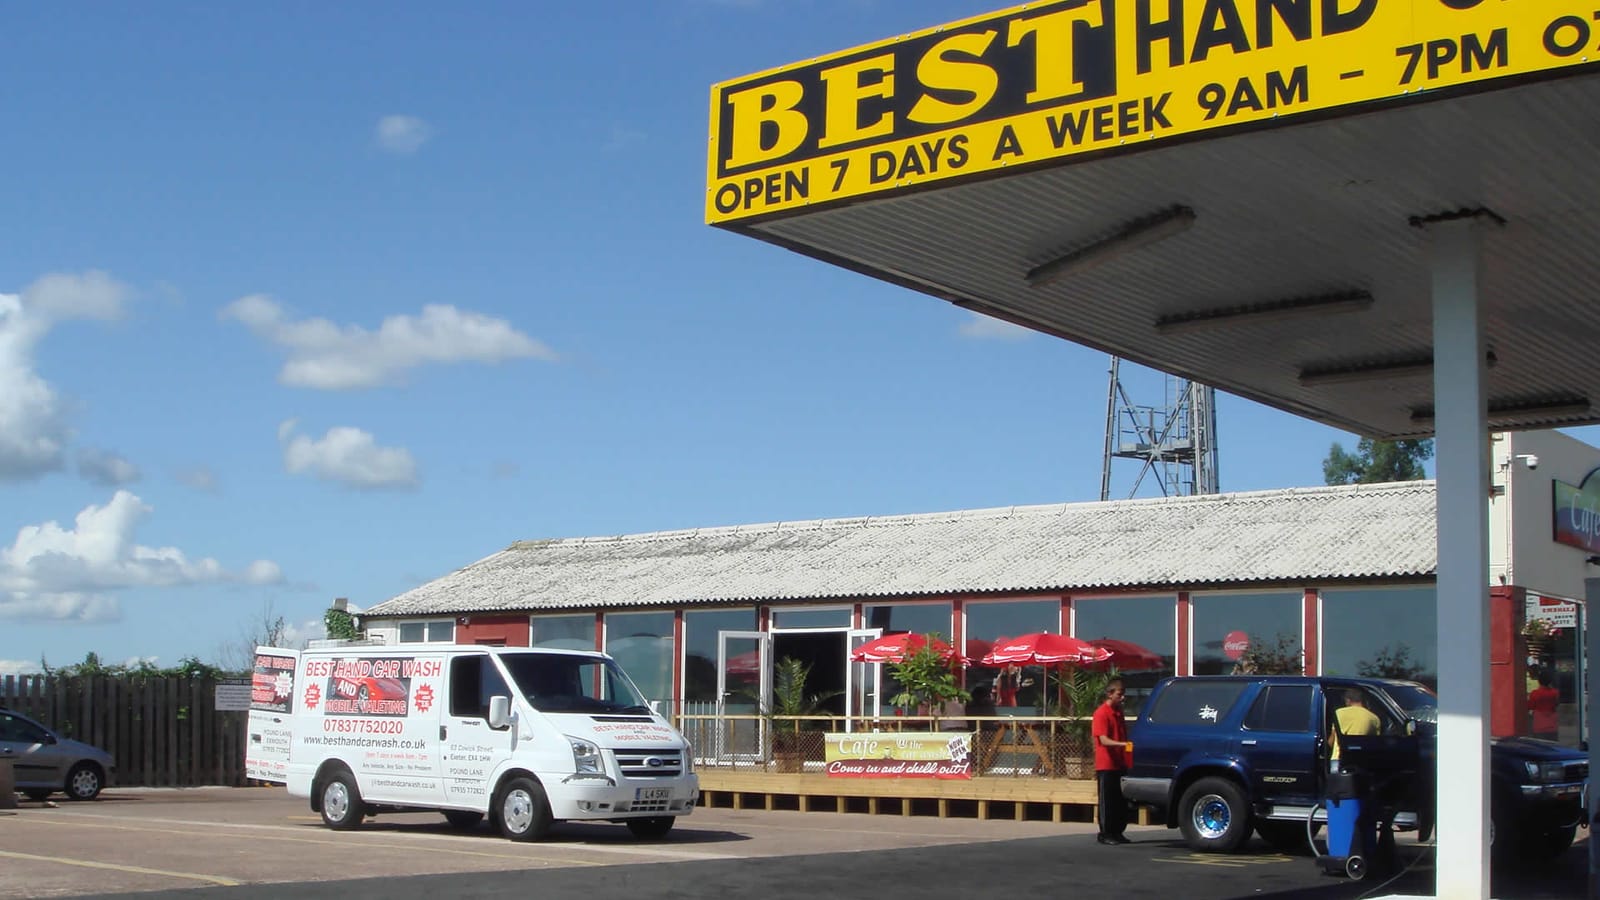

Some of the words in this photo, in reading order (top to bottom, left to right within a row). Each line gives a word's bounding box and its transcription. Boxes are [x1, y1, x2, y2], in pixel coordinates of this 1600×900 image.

[726, 1, 1103, 169] BEST
[715, 167, 809, 214] OPEN
[830, 159, 849, 192] 7
[869, 135, 969, 184] DAYS
[992, 125, 1024, 161] A
[1046, 93, 1173, 148] WEEK
[1197, 66, 1309, 120] 9AM
[1395, 28, 1508, 86] 7PM
[306, 661, 335, 677] BEST
[336, 661, 371, 677] HAND
[374, 661, 400, 678] CAR
[403, 662, 441, 678] WASH
[337, 680, 357, 697] AND
[325, 700, 358, 713] MOBILE
[361, 701, 407, 714] VALETING
[323, 719, 404, 734] 07837752020
[303, 735, 426, 749] www.besthandcarwash.co.uk
[949, 737, 963, 750] NOW
[952, 745, 968, 758] OPEN
[829, 761, 865, 774] Come
[880, 761, 906, 774] and
[905, 761, 938, 774] chill
